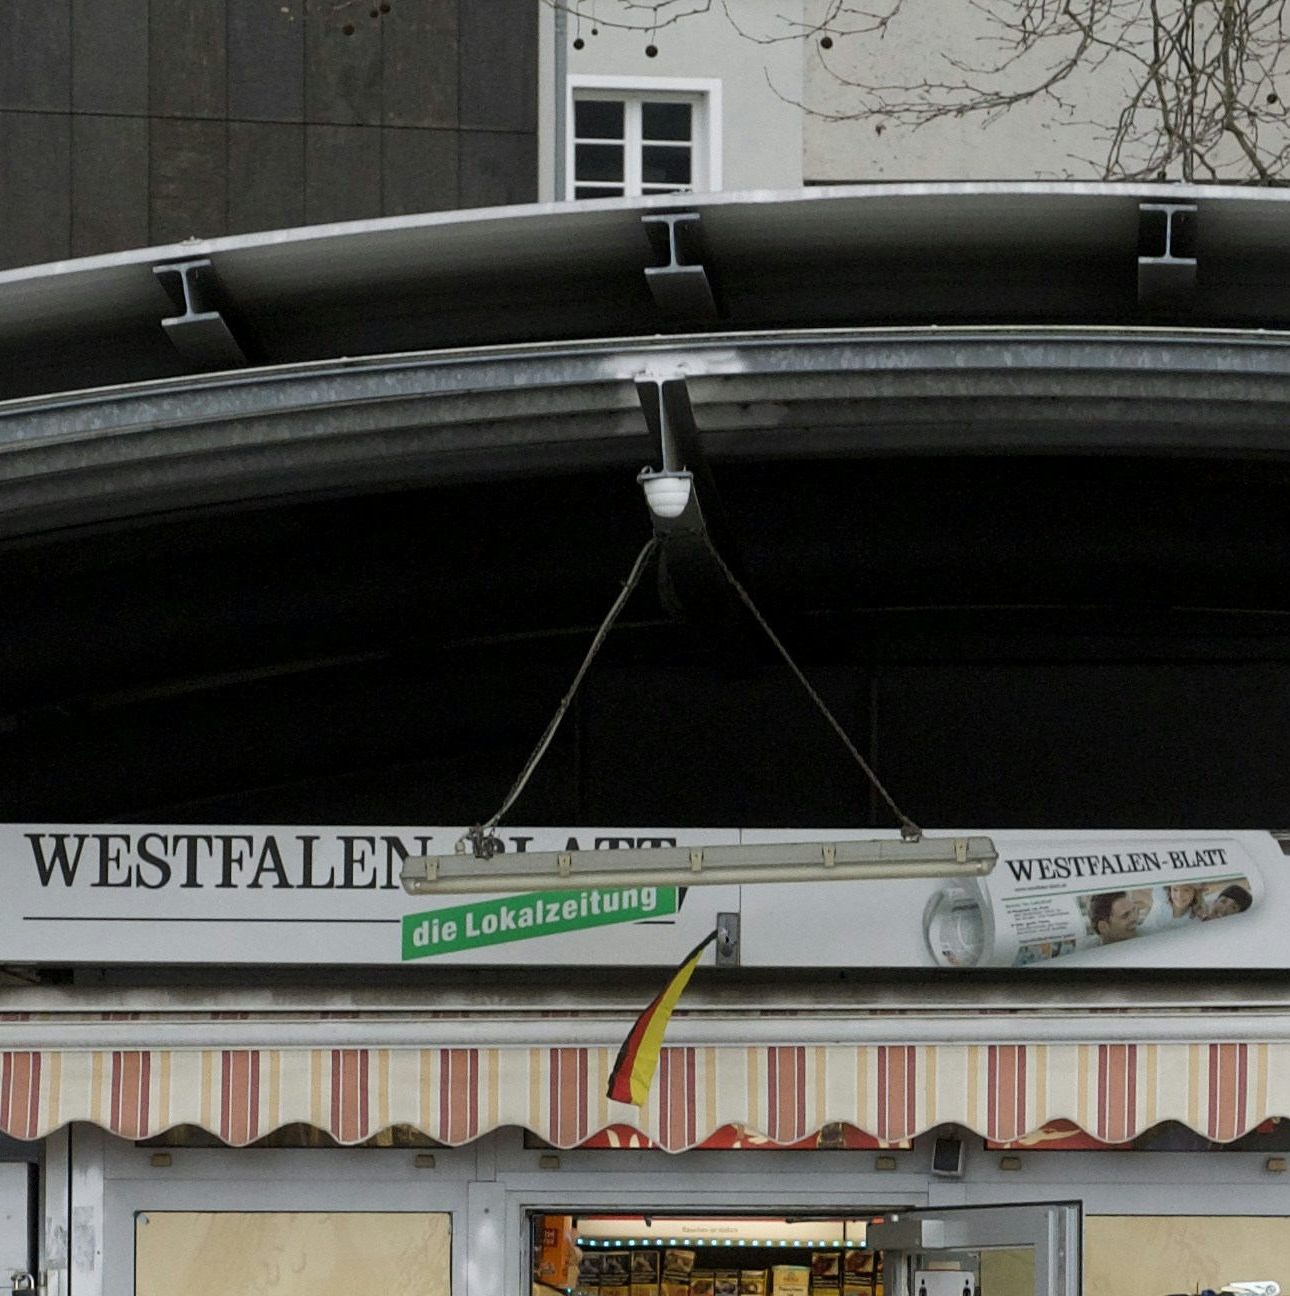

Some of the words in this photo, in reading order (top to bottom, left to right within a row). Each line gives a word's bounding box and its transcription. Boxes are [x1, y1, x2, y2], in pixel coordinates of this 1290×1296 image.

[1005, 848, 1229, 882] WESTFALEN-BLATT
[412, 917, 457, 947] die
[465, 885, 657, 938] Lokalzeitung
